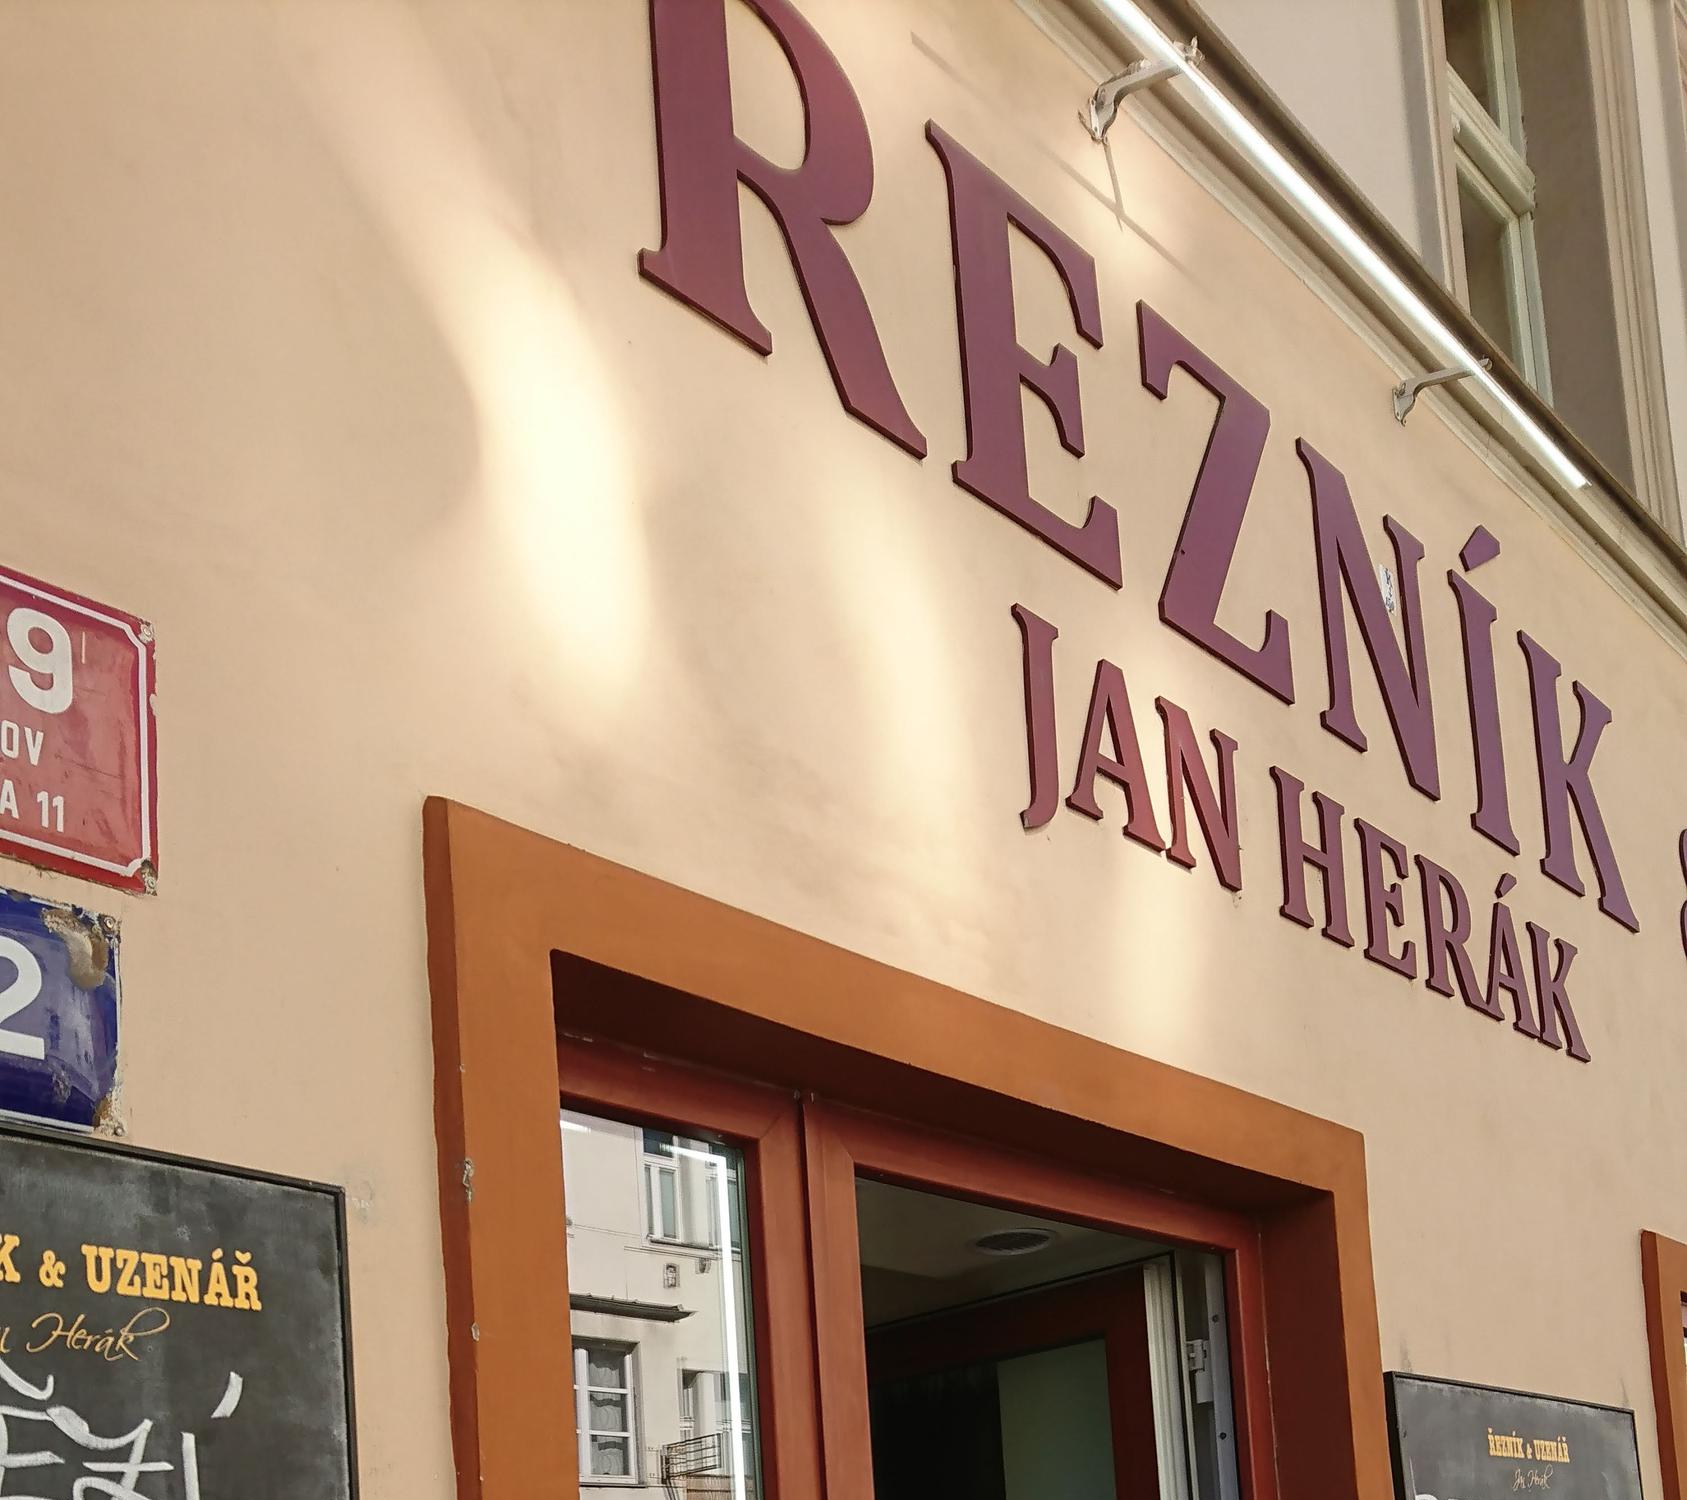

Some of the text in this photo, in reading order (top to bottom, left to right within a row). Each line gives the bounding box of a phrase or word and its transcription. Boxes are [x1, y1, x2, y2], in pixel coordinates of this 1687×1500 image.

[7, 607, 74, 714] 9
[37, 791, 65, 833] 11
[1011, 603, 1242, 891] JAN
[1269, 765, 1591, 1062] HERÁK
[39, 1250, 66, 1288] &
[81, 1244, 262, 1311] UZENÁŘ
[26, 1307, 170, 1362] Herák
[1488, 1427, 1525, 1458] ŘEZNÍK
[1533, 1436, 1570, 1463] UZENÁŘ
